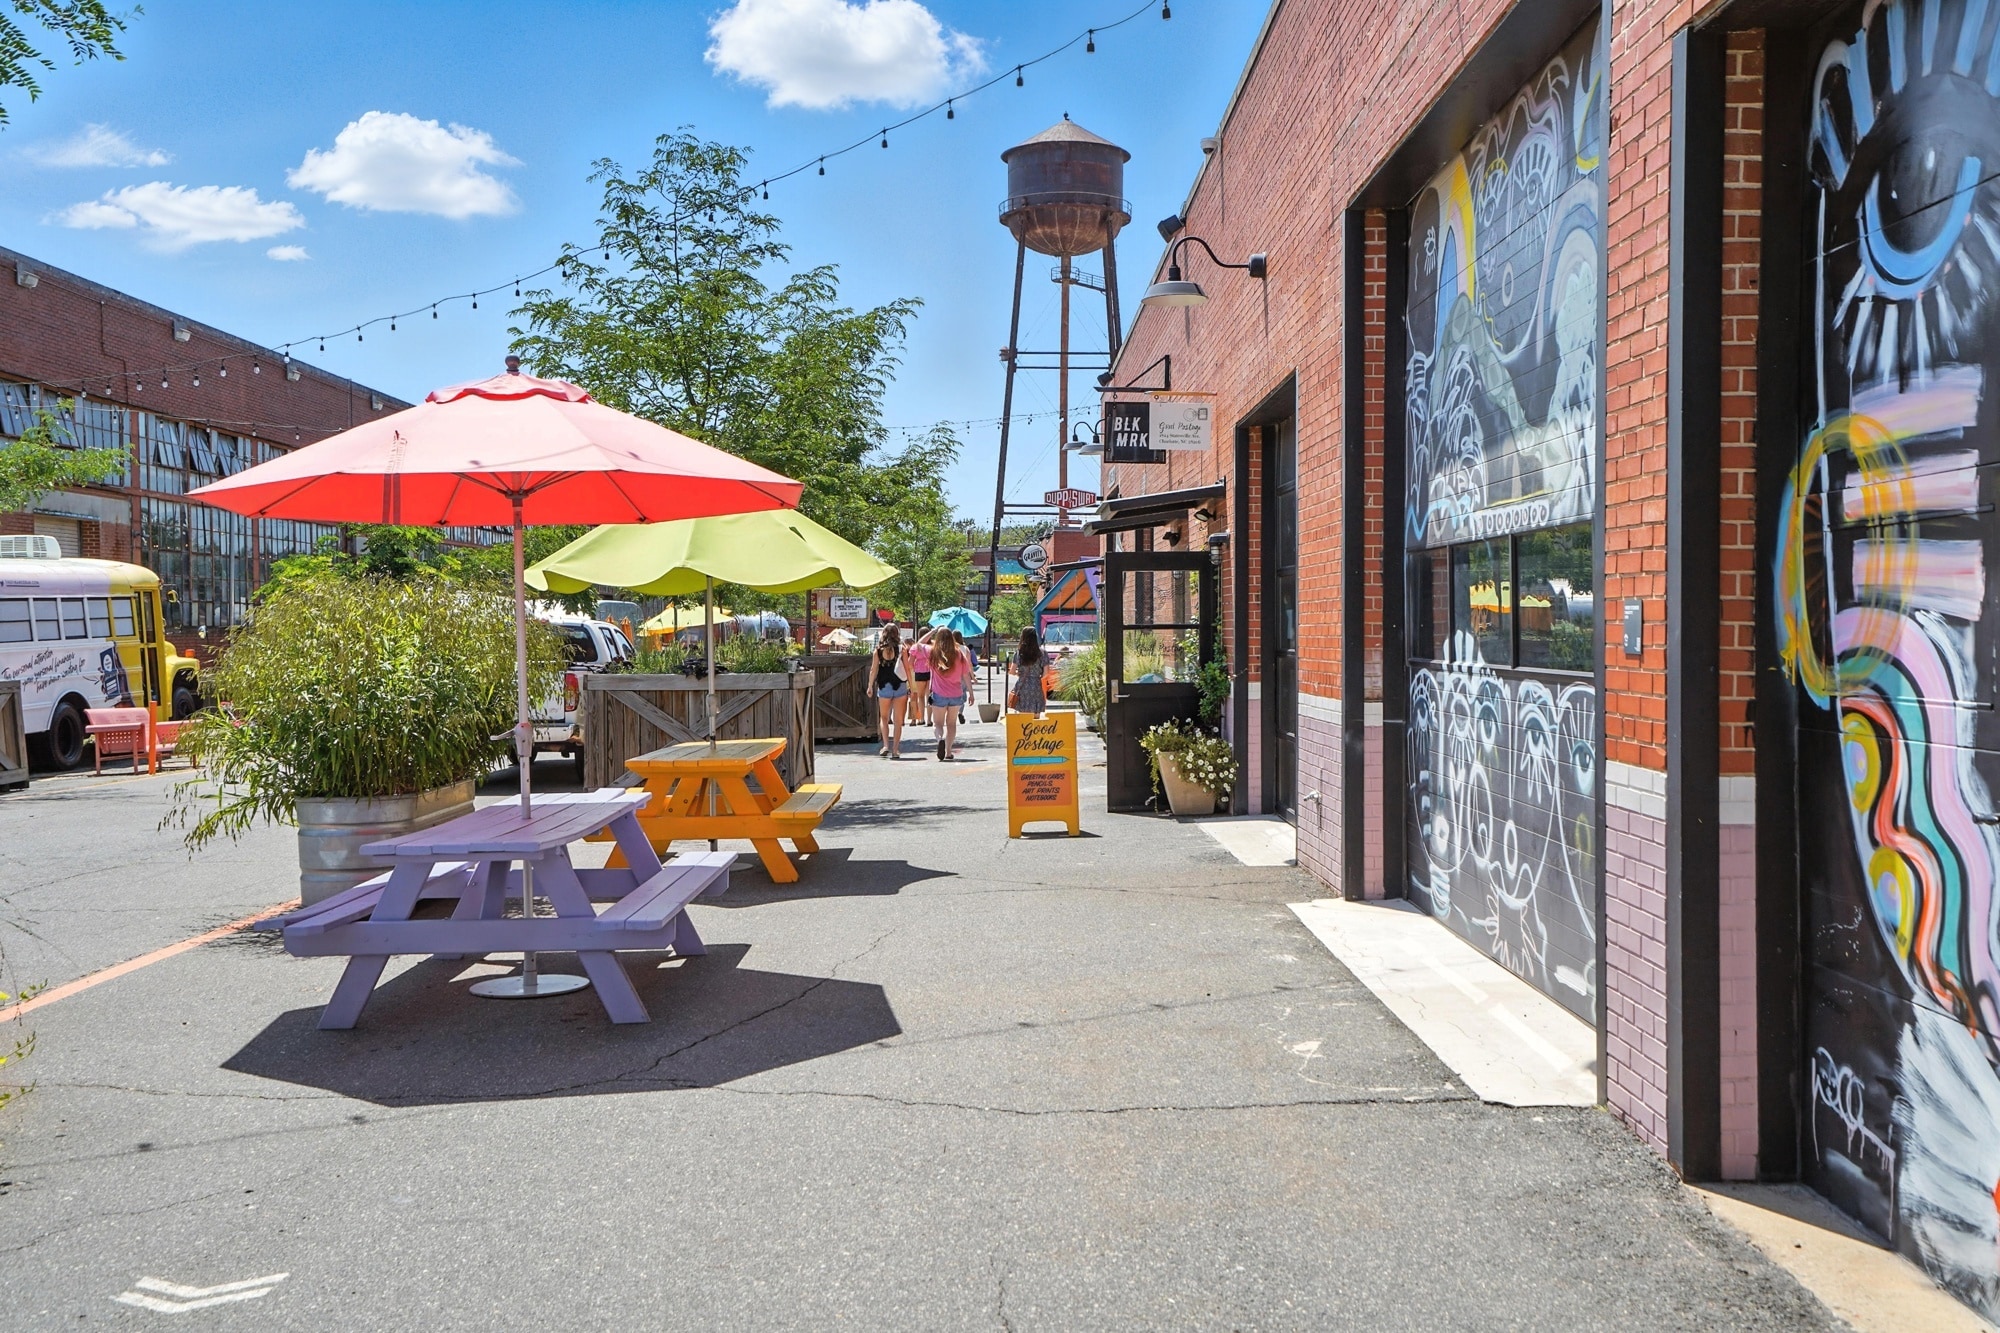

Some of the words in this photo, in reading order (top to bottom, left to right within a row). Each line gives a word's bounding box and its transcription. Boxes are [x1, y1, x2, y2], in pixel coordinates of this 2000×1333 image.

[1114, 417, 1141, 431] BLK
[1116, 433, 1148, 447] MRK
[1024, 550, 1043, 561] GRAVITY
[1021, 720, 1058, 741] Good
[1013, 737, 1064, 756] Postage
[1021, 773, 1047, 781] GREETING
[1047, 772, 1065, 780] CARDS
